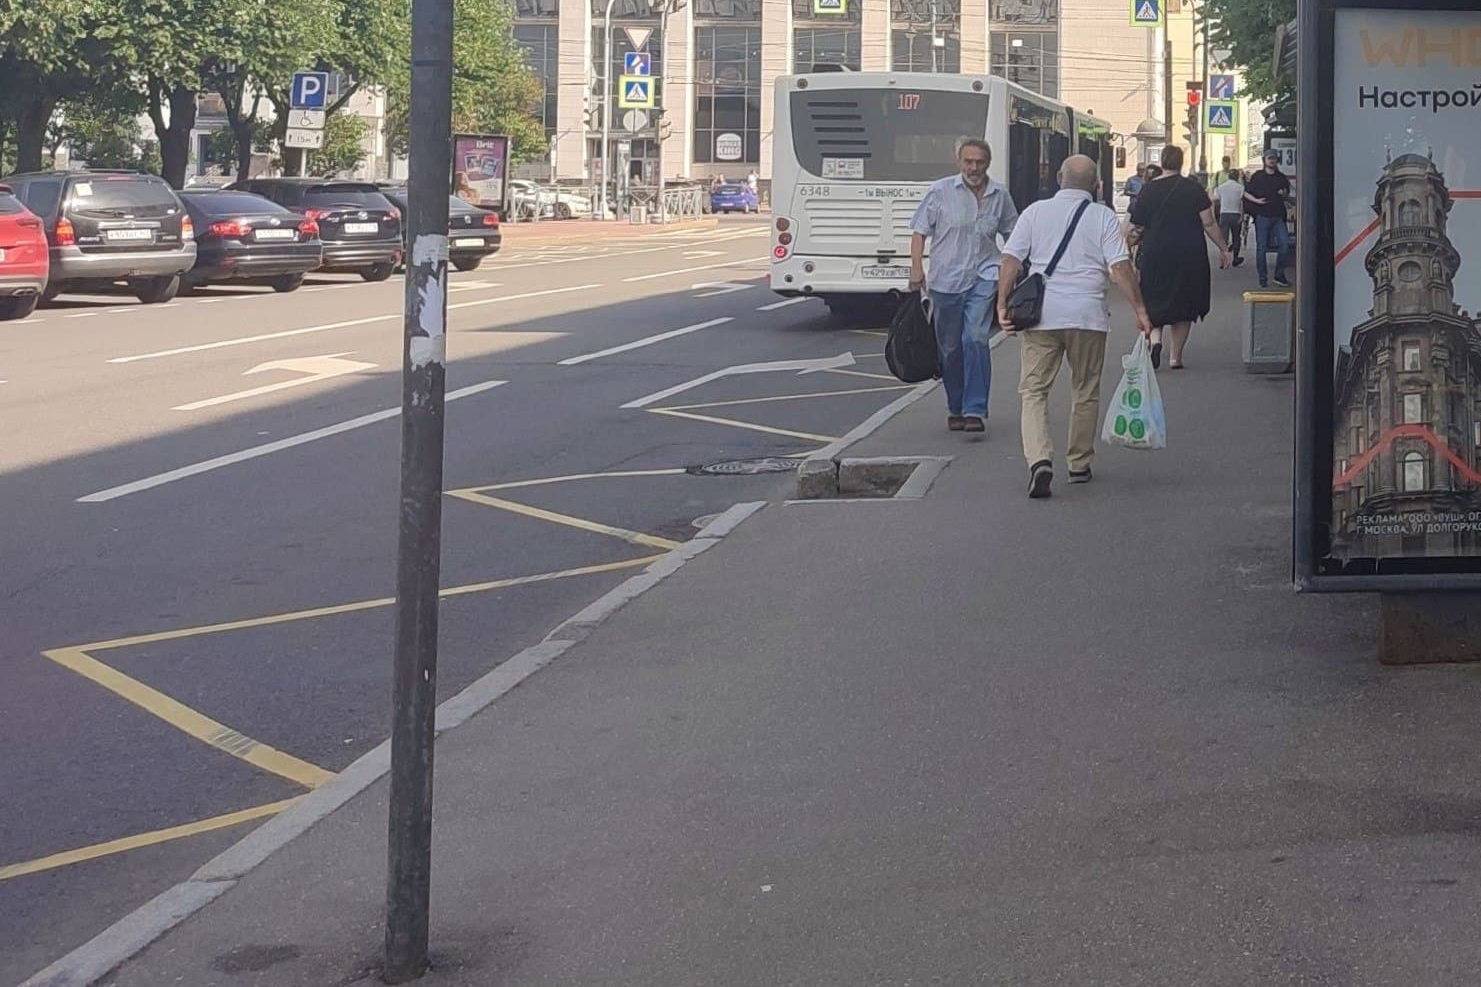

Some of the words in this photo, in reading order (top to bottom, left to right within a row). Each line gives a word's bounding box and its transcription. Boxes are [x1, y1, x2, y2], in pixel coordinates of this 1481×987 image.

[897, 93, 921, 110] 107
[800, 186, 831, 197] 6348
[1408, 513, 1431, 523] ООО
